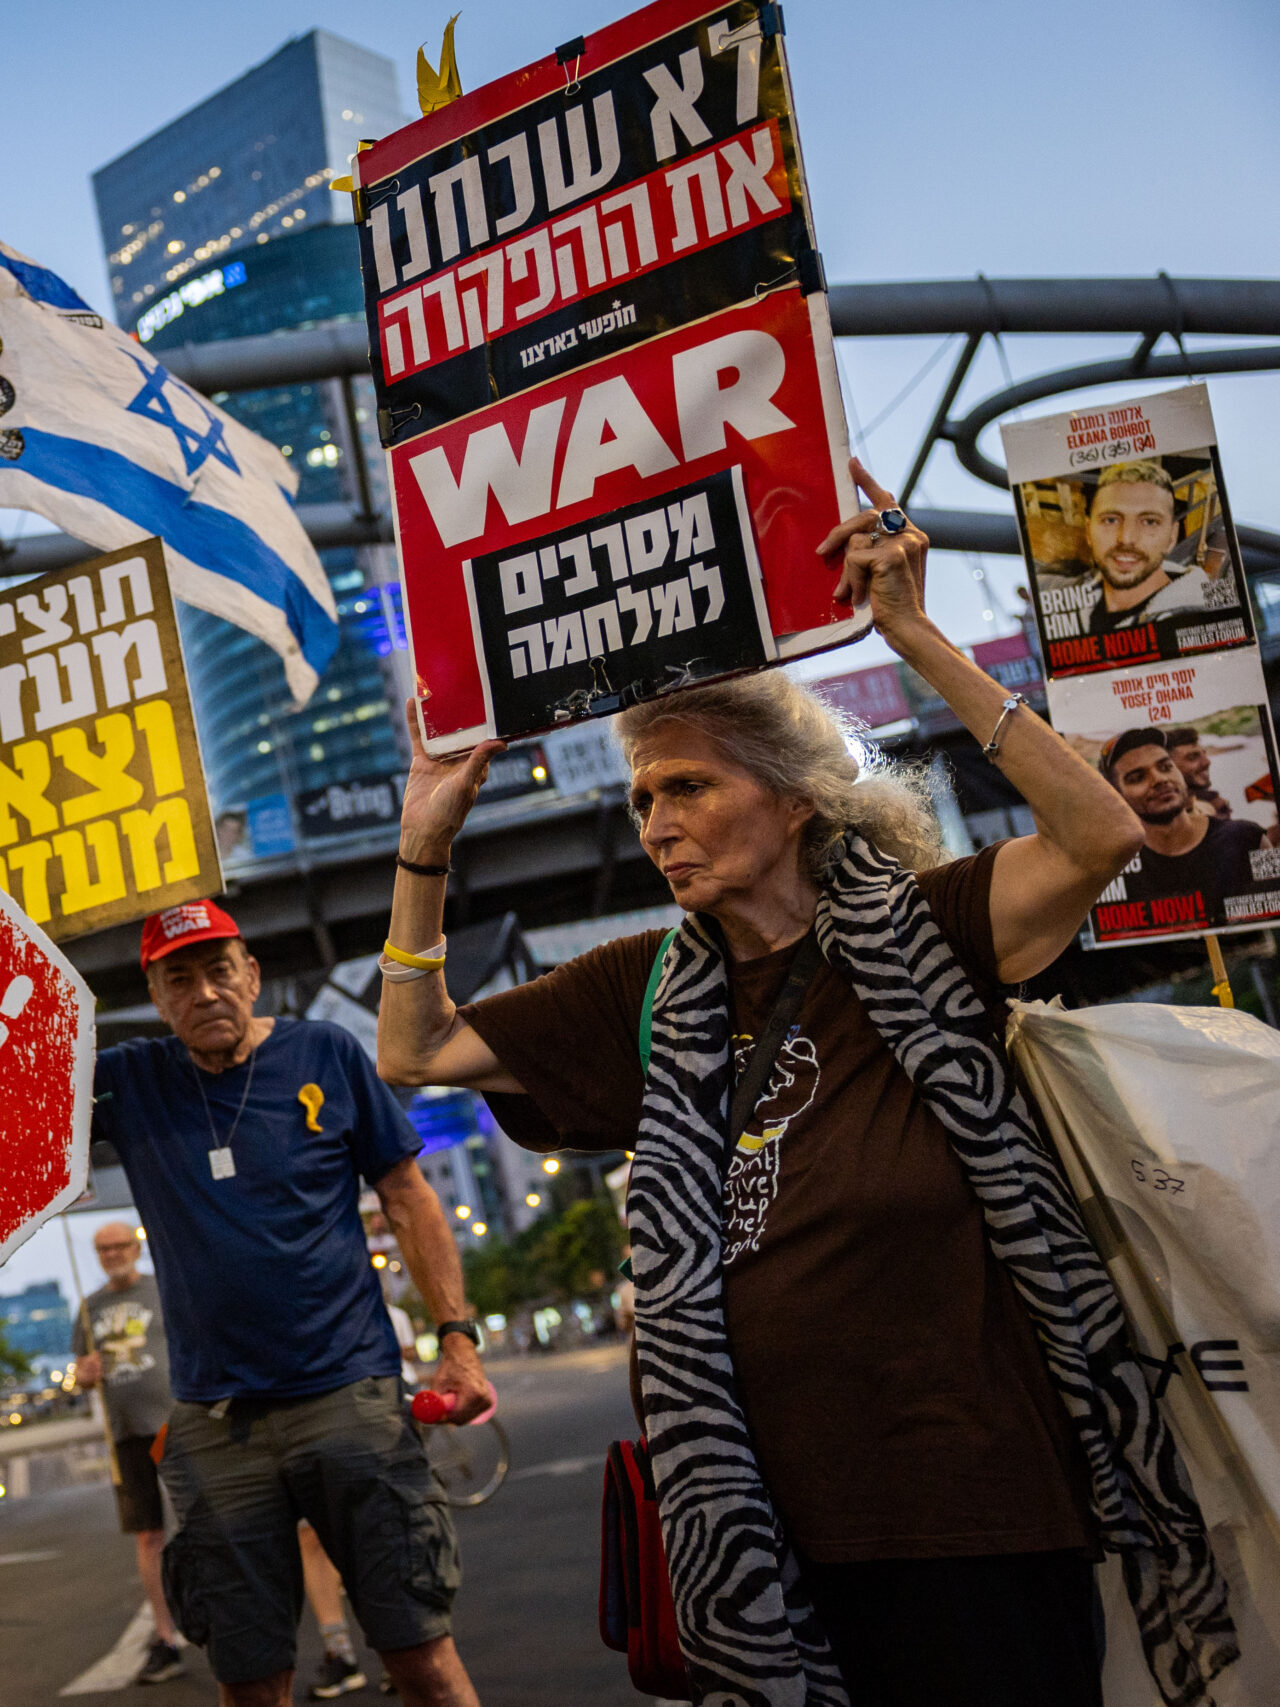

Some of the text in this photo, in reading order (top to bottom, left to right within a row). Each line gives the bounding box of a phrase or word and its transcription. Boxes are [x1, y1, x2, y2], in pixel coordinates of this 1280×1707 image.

[366, 19, 762, 293] לא שכחנו
[665, 127, 783, 253] את
[383, 182, 659, 377] ההפקרה
[519, 327, 579, 369] בארצנו
[1069, 405, 1143, 433] אלקנה בוחבוט
[409, 329, 797, 549] WAR
[1067, 419, 1151, 450] ELKANA BOHBOT
[1070, 447, 1100, 467] (36)
[498, 491, 717, 615] מסרבים
[1039, 584, 1098, 615] BRING
[507, 561, 726, 679] למלחמה
[1043, 612, 1080, 640] HIM
[1048, 623, 1159, 667] HOME NOW!
[1178, 625, 1246, 649] FAMILIES FORUM
[1146, 672, 1170, 689] חיים
[1172, 668, 1196, 687] יוסף
[1120, 685, 1194, 710] YOSEF OHANA
[1148, 705, 1172, 722] (24)
[1096, 890, 1206, 931] HOME NOW!
[1225, 900, 1264, 918] FAMILIES
[723, 1177, 769, 1205] give
[738, 1195, 768, 1222] up
